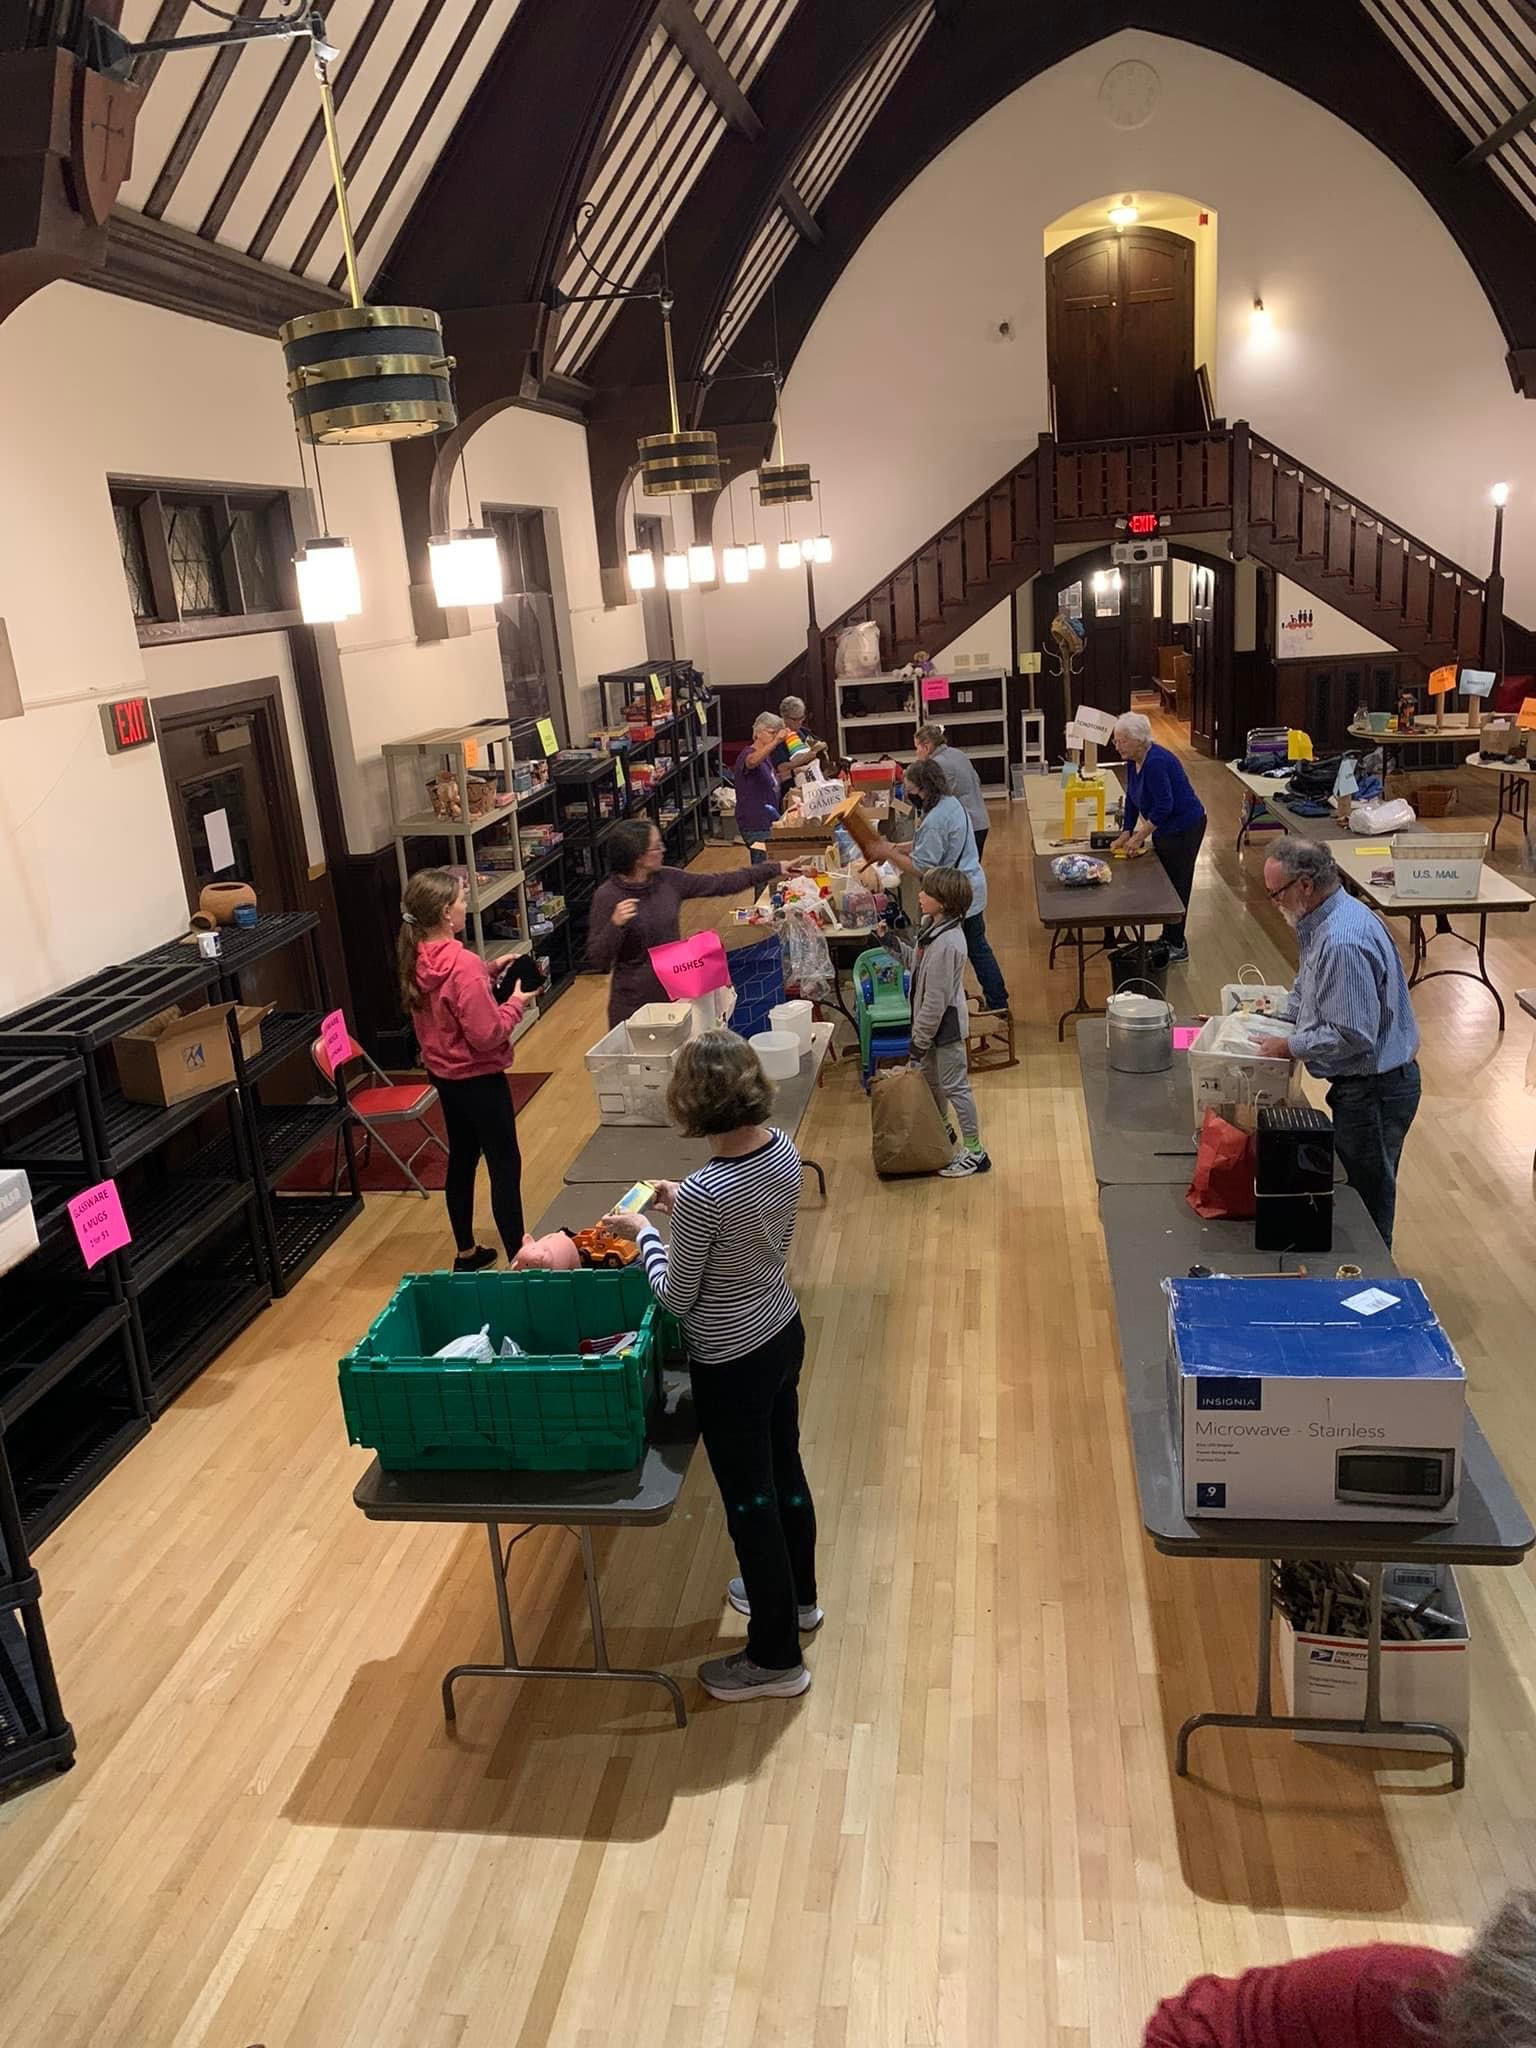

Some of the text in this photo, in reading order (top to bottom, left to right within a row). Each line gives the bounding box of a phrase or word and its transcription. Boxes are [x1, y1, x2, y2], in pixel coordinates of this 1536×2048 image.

[1132, 515, 1155, 533] EXIT
[115, 699, 148, 745] EXIT
[808, 786, 831, 798] TOYS
[808, 796, 841, 810] GAMES
[1412, 870, 1460, 880] U.S. MAIL
[672, 958, 705, 974] DISHES
[1195, 1421, 1290, 1437] Microwave
[1307, 1422, 1385, 1439] Stainless
